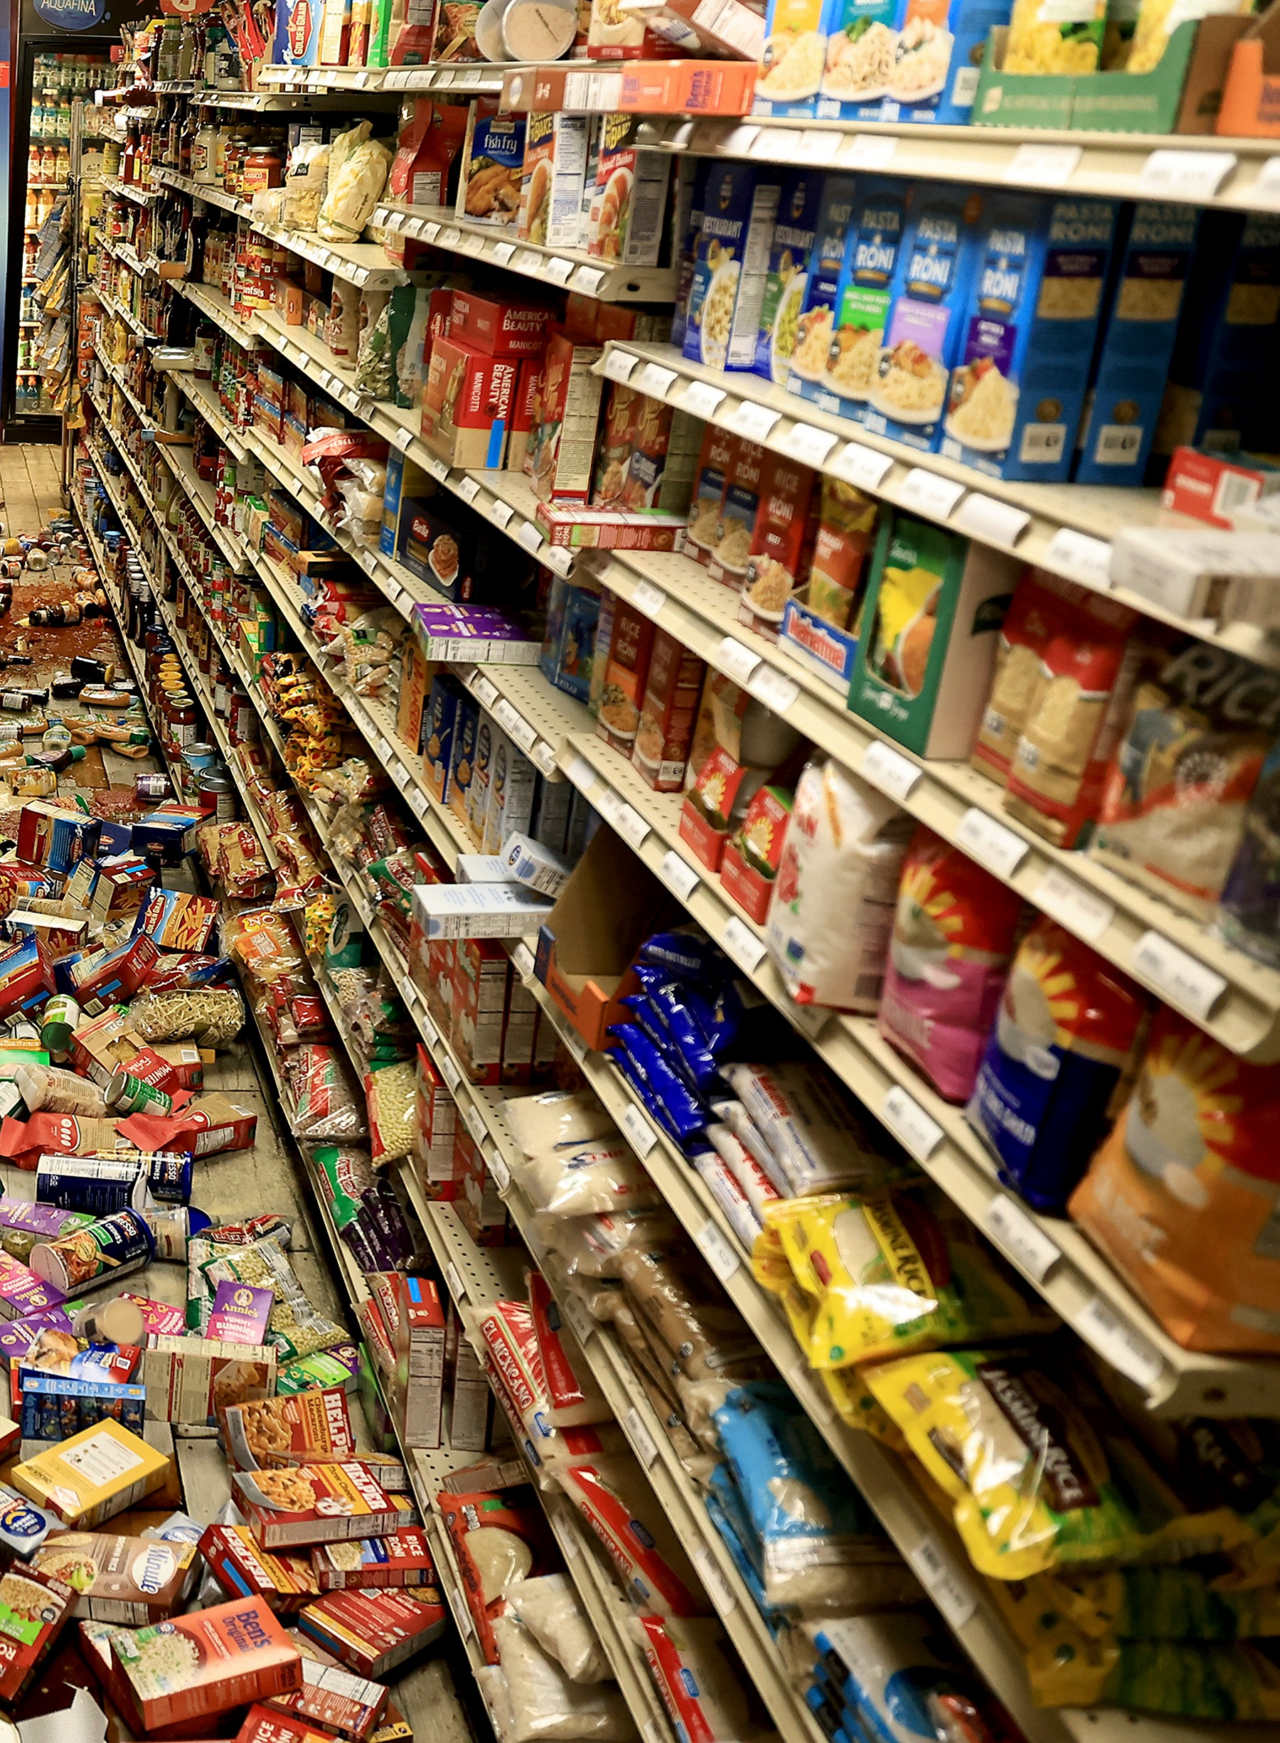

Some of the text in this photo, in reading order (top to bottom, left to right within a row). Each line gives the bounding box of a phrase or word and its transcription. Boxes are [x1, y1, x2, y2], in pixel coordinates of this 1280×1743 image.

[483, 134, 518, 156] fish fry
[858, 246, 896, 270] RONI
[911, 255, 951, 284] RONI
[983, 267, 1020, 297] RONI
[503, 318, 543, 332] BEAUTY
[469, 371, 484, 412] MANICOTTI
[489, 363, 504, 404] BEAUTY
[500, 364, 516, 420] AMERICAN
[768, 499, 794, 521] RONI
[221, 1301, 260, 1319] Annie's
[223, 1315, 253, 1330] YUMMY
[216, 1321, 257, 1339] BUNNIES
[482, 1319, 533, 1409] EL MEXICANO
[341, 1461, 387, 1511] HELPER
[220, 1525, 277, 1590] HELPER
[388, 1535, 406, 1558] RONI
[405, 1535, 425, 1558] RICE
[591, 1516, 634, 1575] MEXICANO
[140, 1543, 172, 1595] Minute
[222, 1616, 257, 1653] Original
[237, 1609, 272, 1651] Ben's
